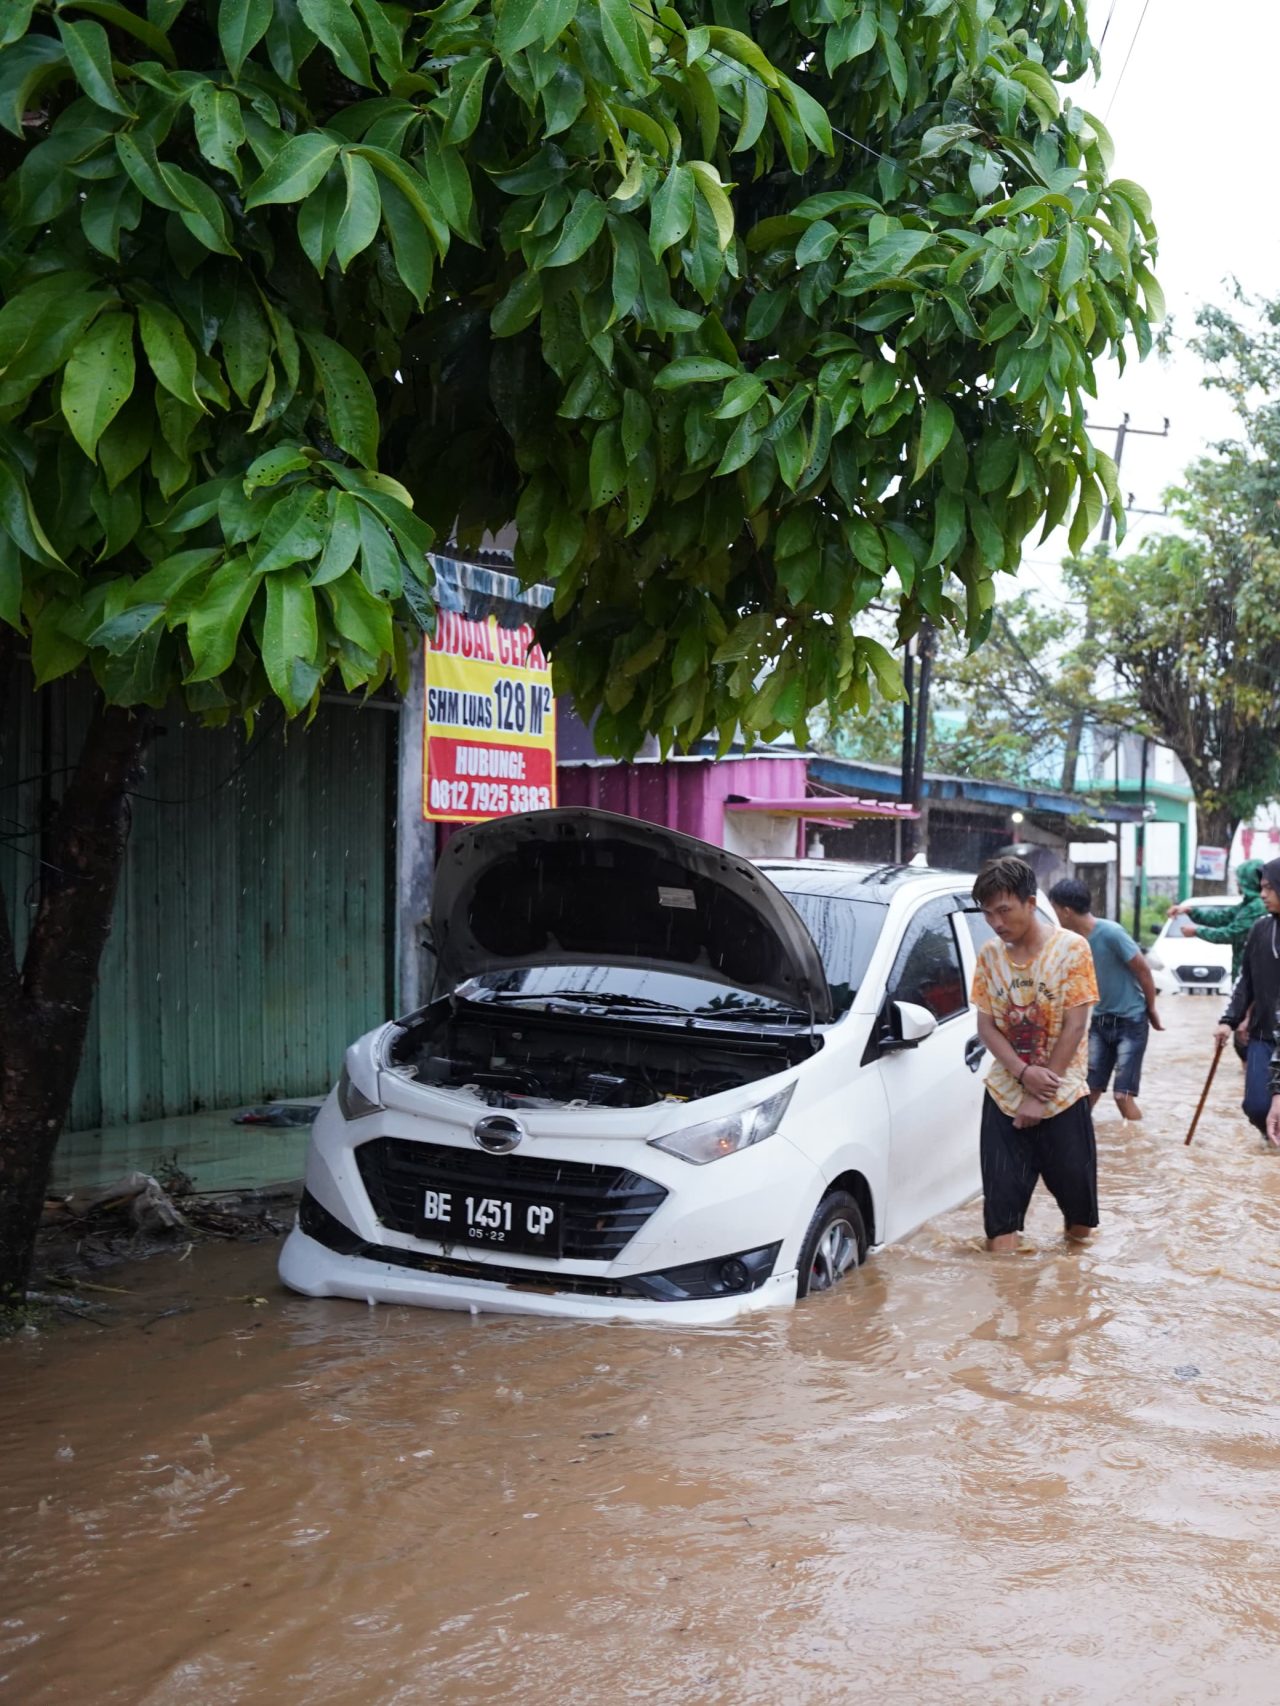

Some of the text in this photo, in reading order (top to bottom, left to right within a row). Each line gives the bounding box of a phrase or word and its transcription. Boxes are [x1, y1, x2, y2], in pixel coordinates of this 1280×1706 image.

[496, 622, 548, 672] CEPA
[428, 688, 459, 724] SHM
[462, 693, 493, 729] LUAS
[494, 679, 526, 733] 128
[430, 778, 551, 814] 0812 7925 3383
[424, 1190, 555, 1236] BE 1451 CP
